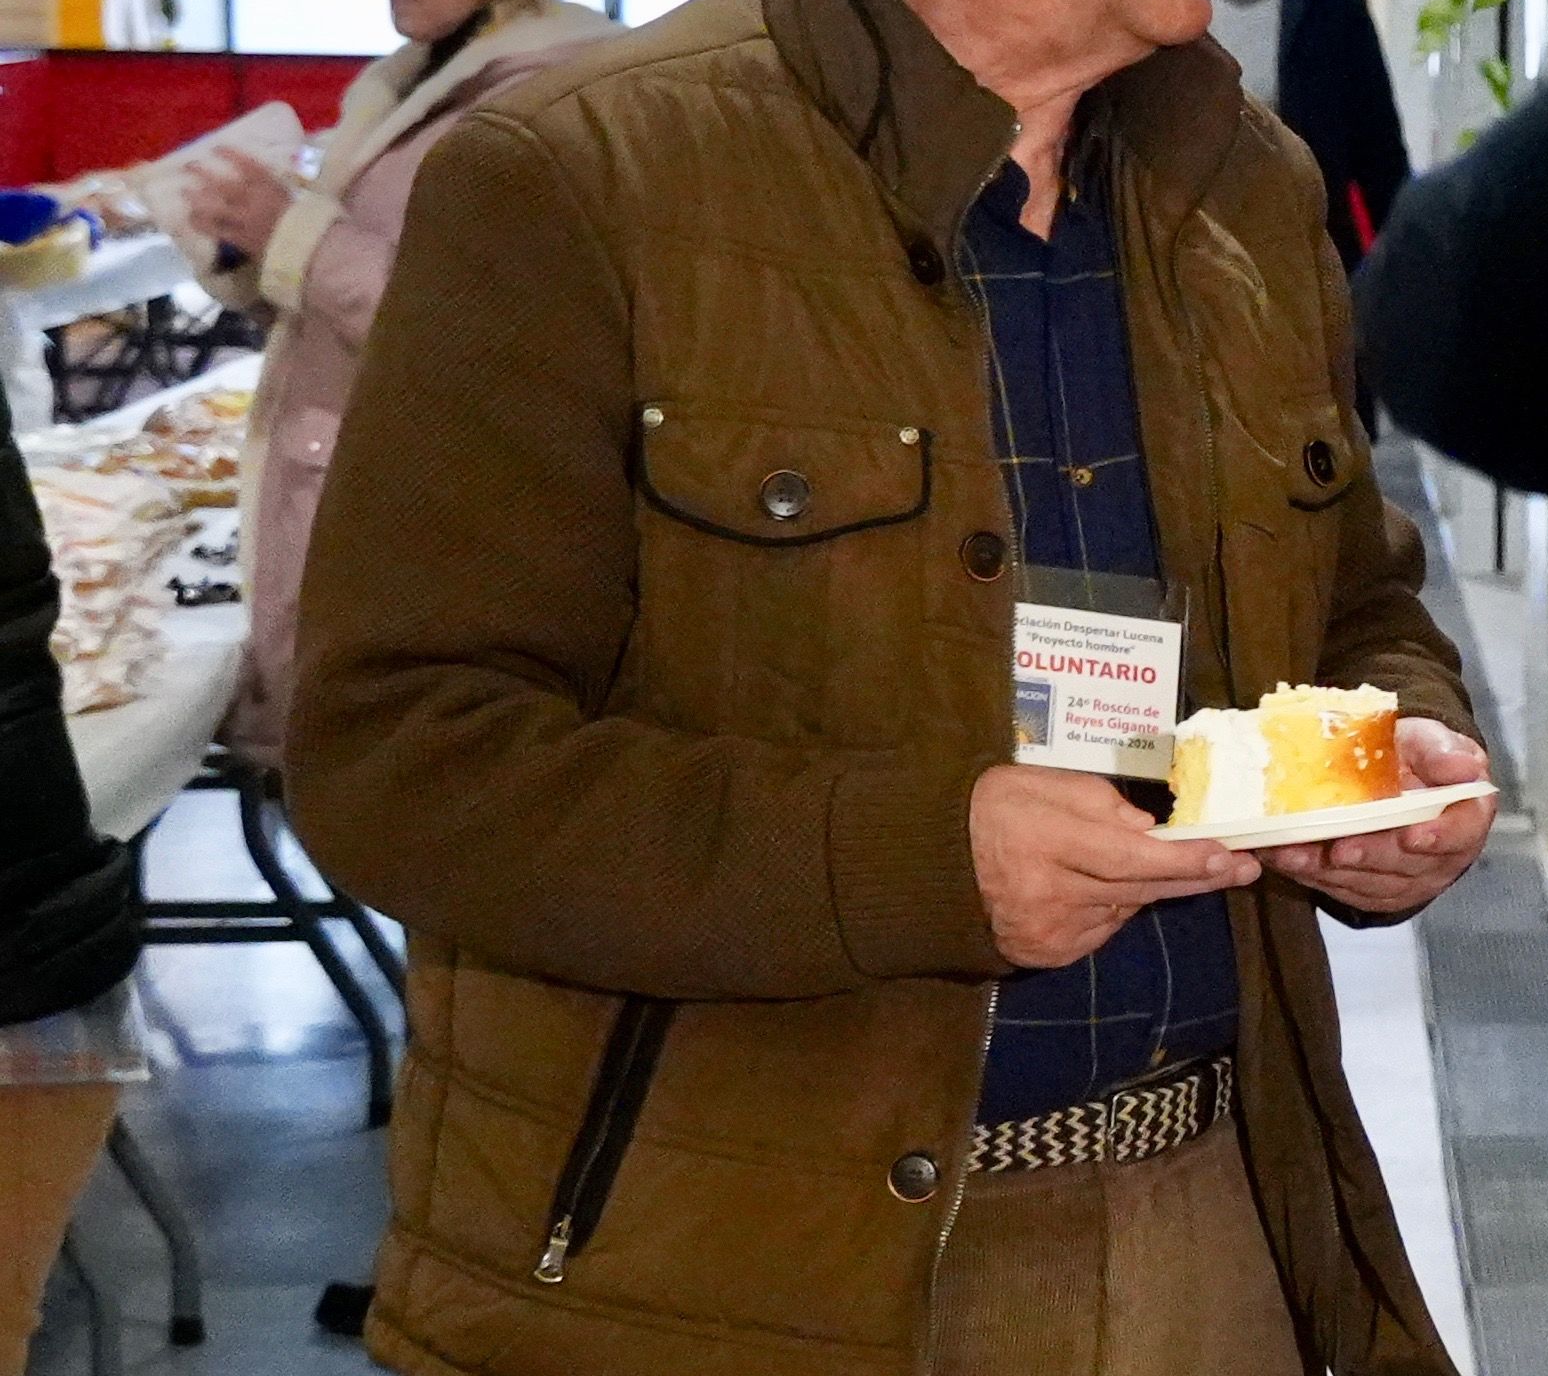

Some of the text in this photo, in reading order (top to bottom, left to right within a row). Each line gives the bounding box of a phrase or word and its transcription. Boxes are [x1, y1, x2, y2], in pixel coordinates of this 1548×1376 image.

[1017, 616, 1164, 643] ciación Despertar Lucena
[1017, 650, 1157, 684] OLUNTARIO
[1093, 699, 1139, 714] Roscón
[1143, 706, 1160, 718] de
[1065, 712, 1159, 735] Reyes Gigante
[1067, 730, 1081, 741] de
[1085, 732, 1124, 747] Lucena
